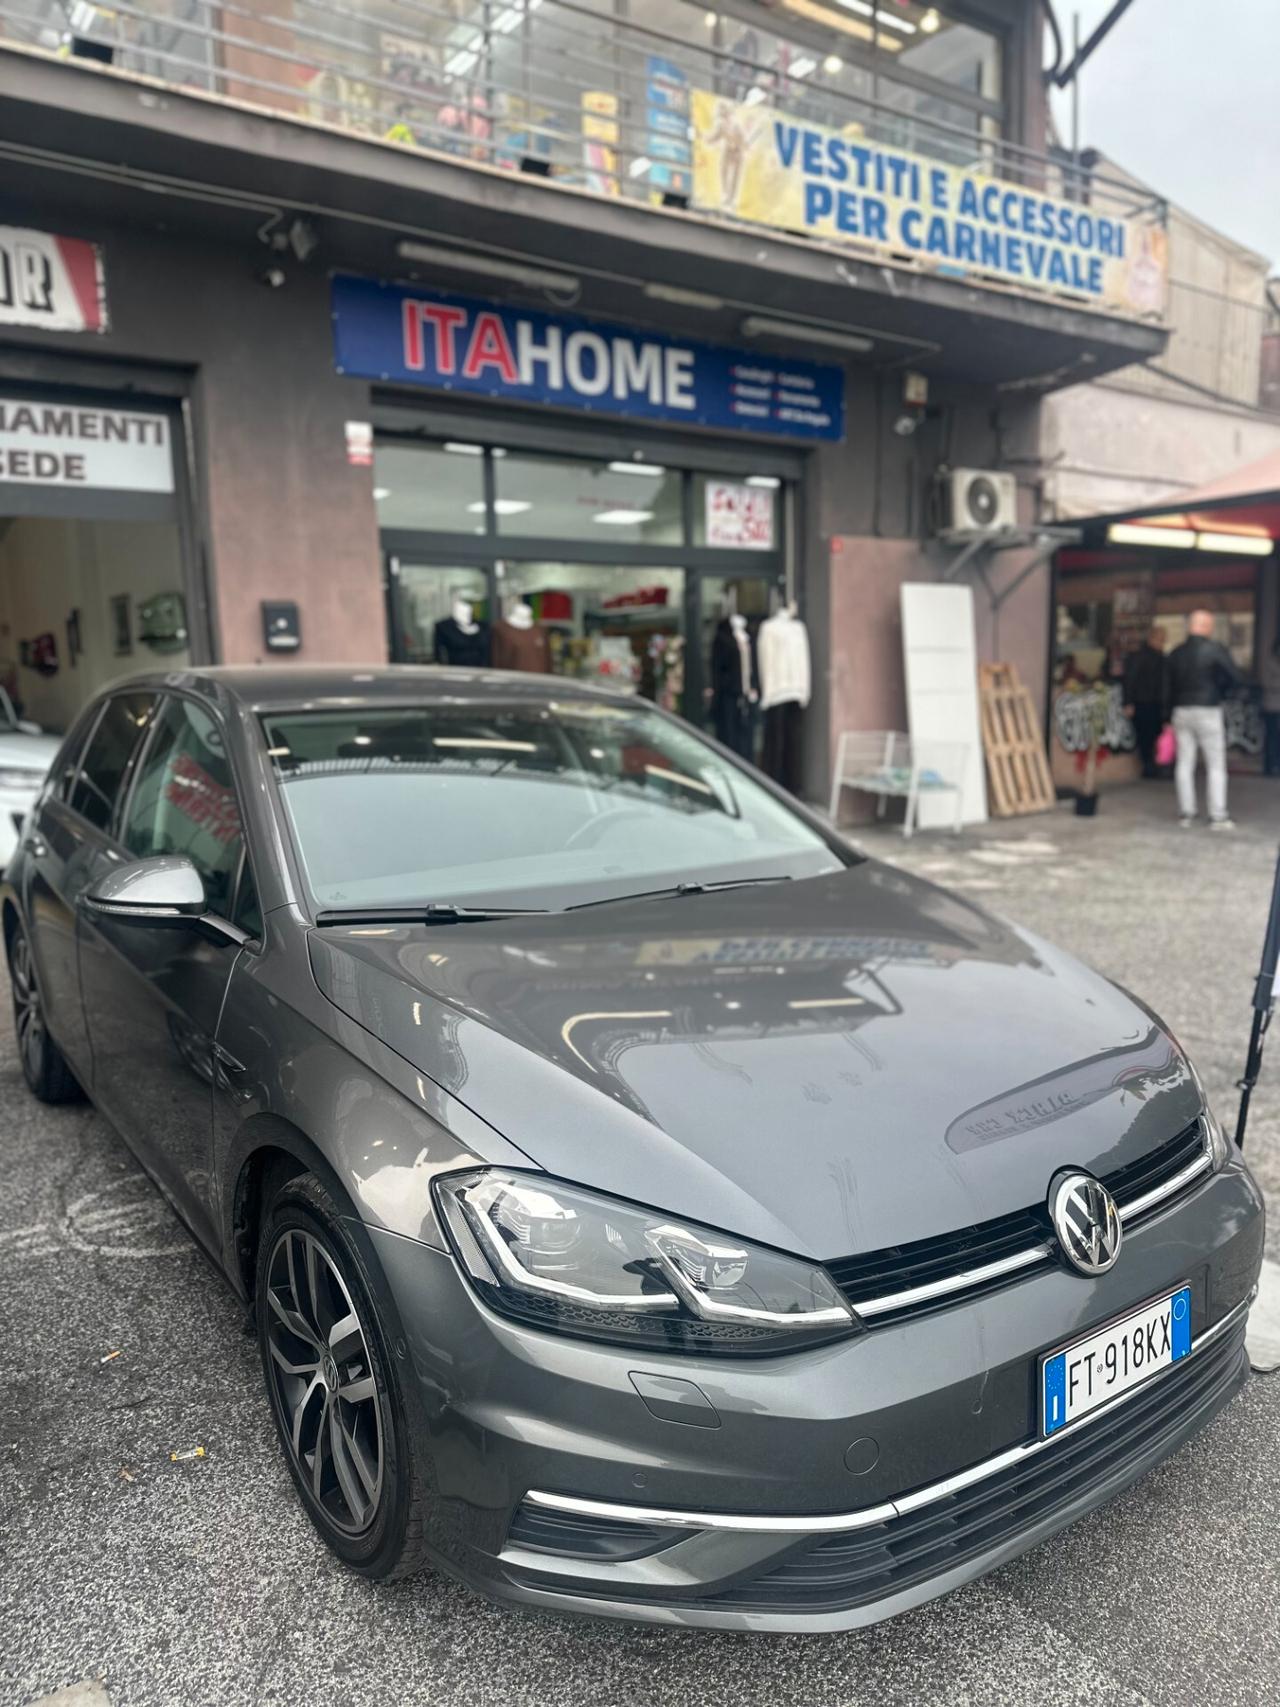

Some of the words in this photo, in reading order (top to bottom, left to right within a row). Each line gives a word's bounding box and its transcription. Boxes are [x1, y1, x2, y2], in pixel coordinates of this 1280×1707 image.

[774, 121, 920, 201] VESTITI
[930, 169, 948, 209] E
[958, 179, 1126, 258] ACCESSORI
[803, 182, 888, 241] PER
[900, 209, 1104, 294] CARNEVALE
[402, 298, 696, 410] ITAHOME
[0, 447, 86, 481] EDE
